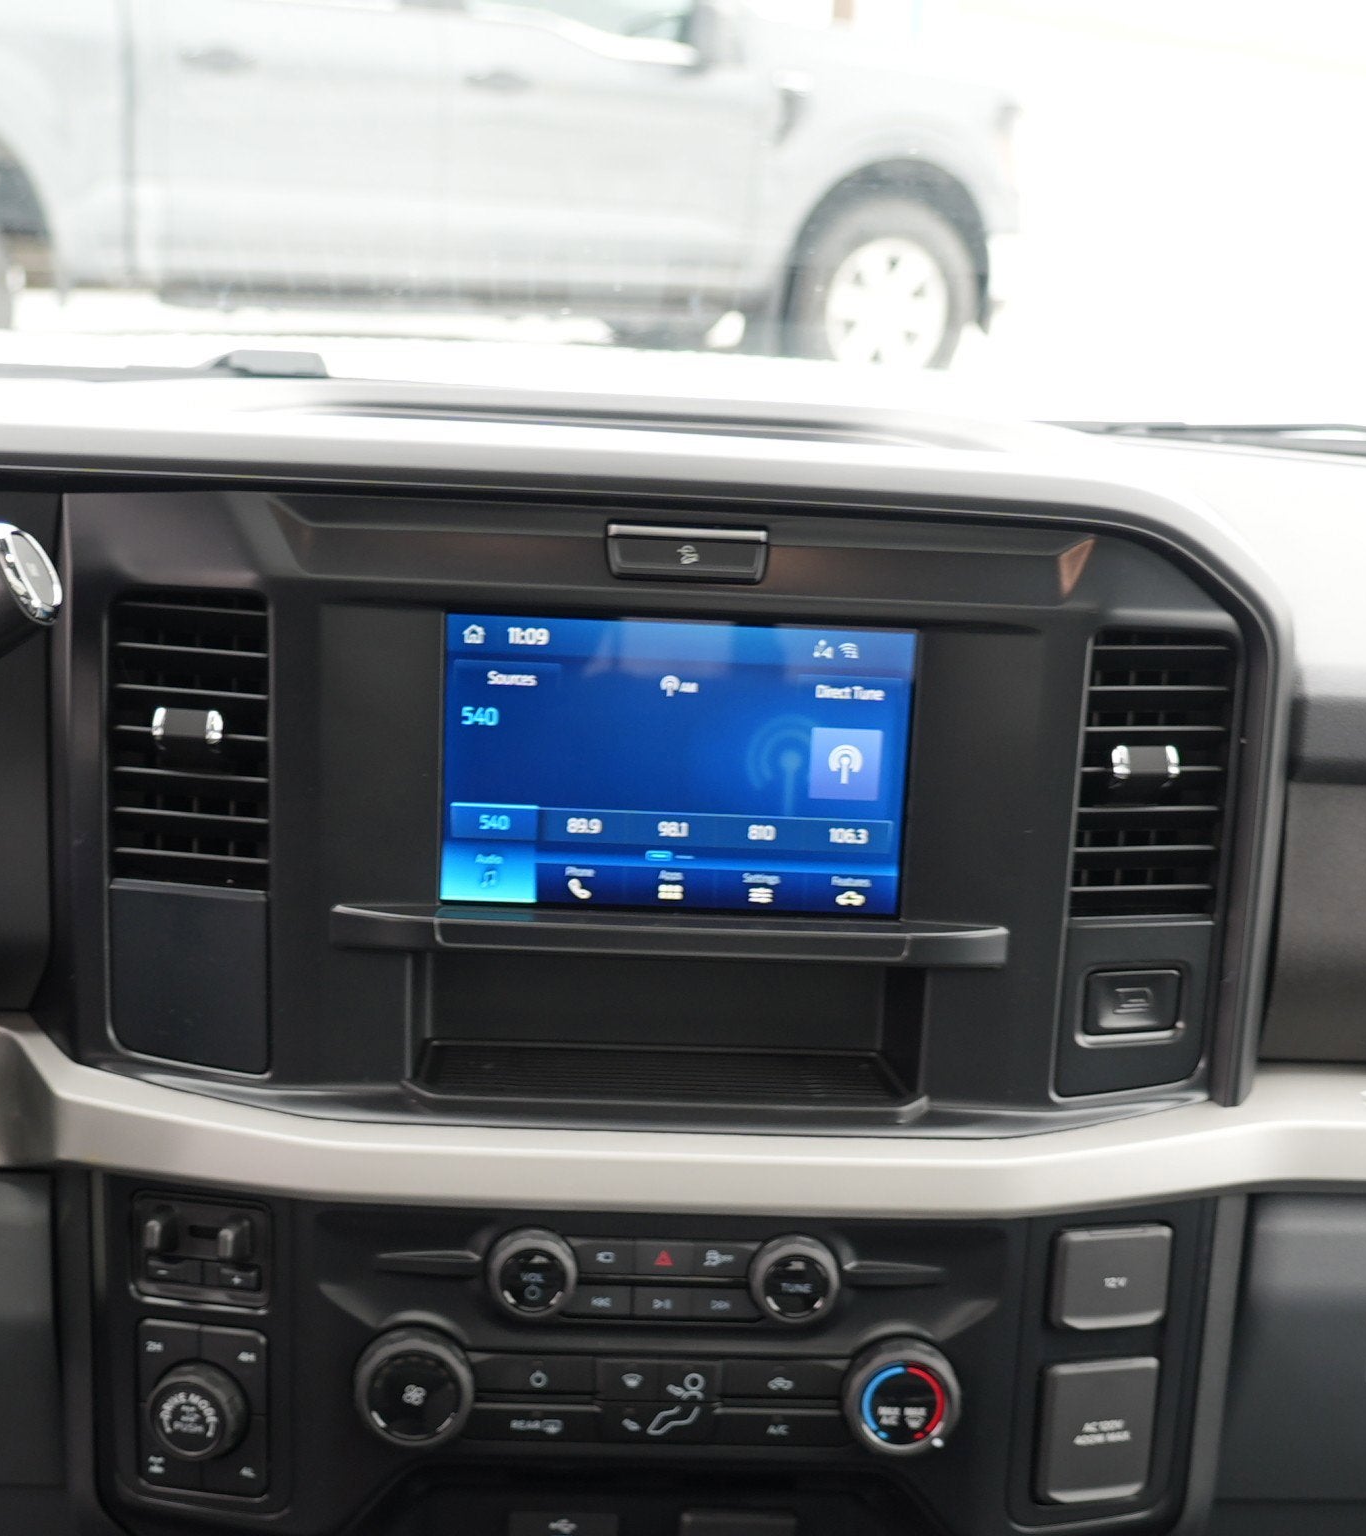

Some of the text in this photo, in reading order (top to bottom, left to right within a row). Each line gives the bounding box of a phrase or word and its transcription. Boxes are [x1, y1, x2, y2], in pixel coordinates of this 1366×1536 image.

[507, 626, 550, 646] 11:09
[487, 669, 538, 687] Sources
[815, 684, 886, 702] Direct Tune
[461, 706, 500, 727] 540
[478, 814, 511, 831] 540
[566, 817, 603, 835] 89.9
[657, 821, 690, 838] 98.1
[747, 824, 777, 841] 810
[828, 827, 869, 845] 106.3
[475, 853, 503, 865] Audio
[565, 866, 596, 878] Phone
[520, 1272, 545, 1283] VOL
[780, 1282, 813, 1294] TUNE
[766, 1424, 790, 1436] A/C
